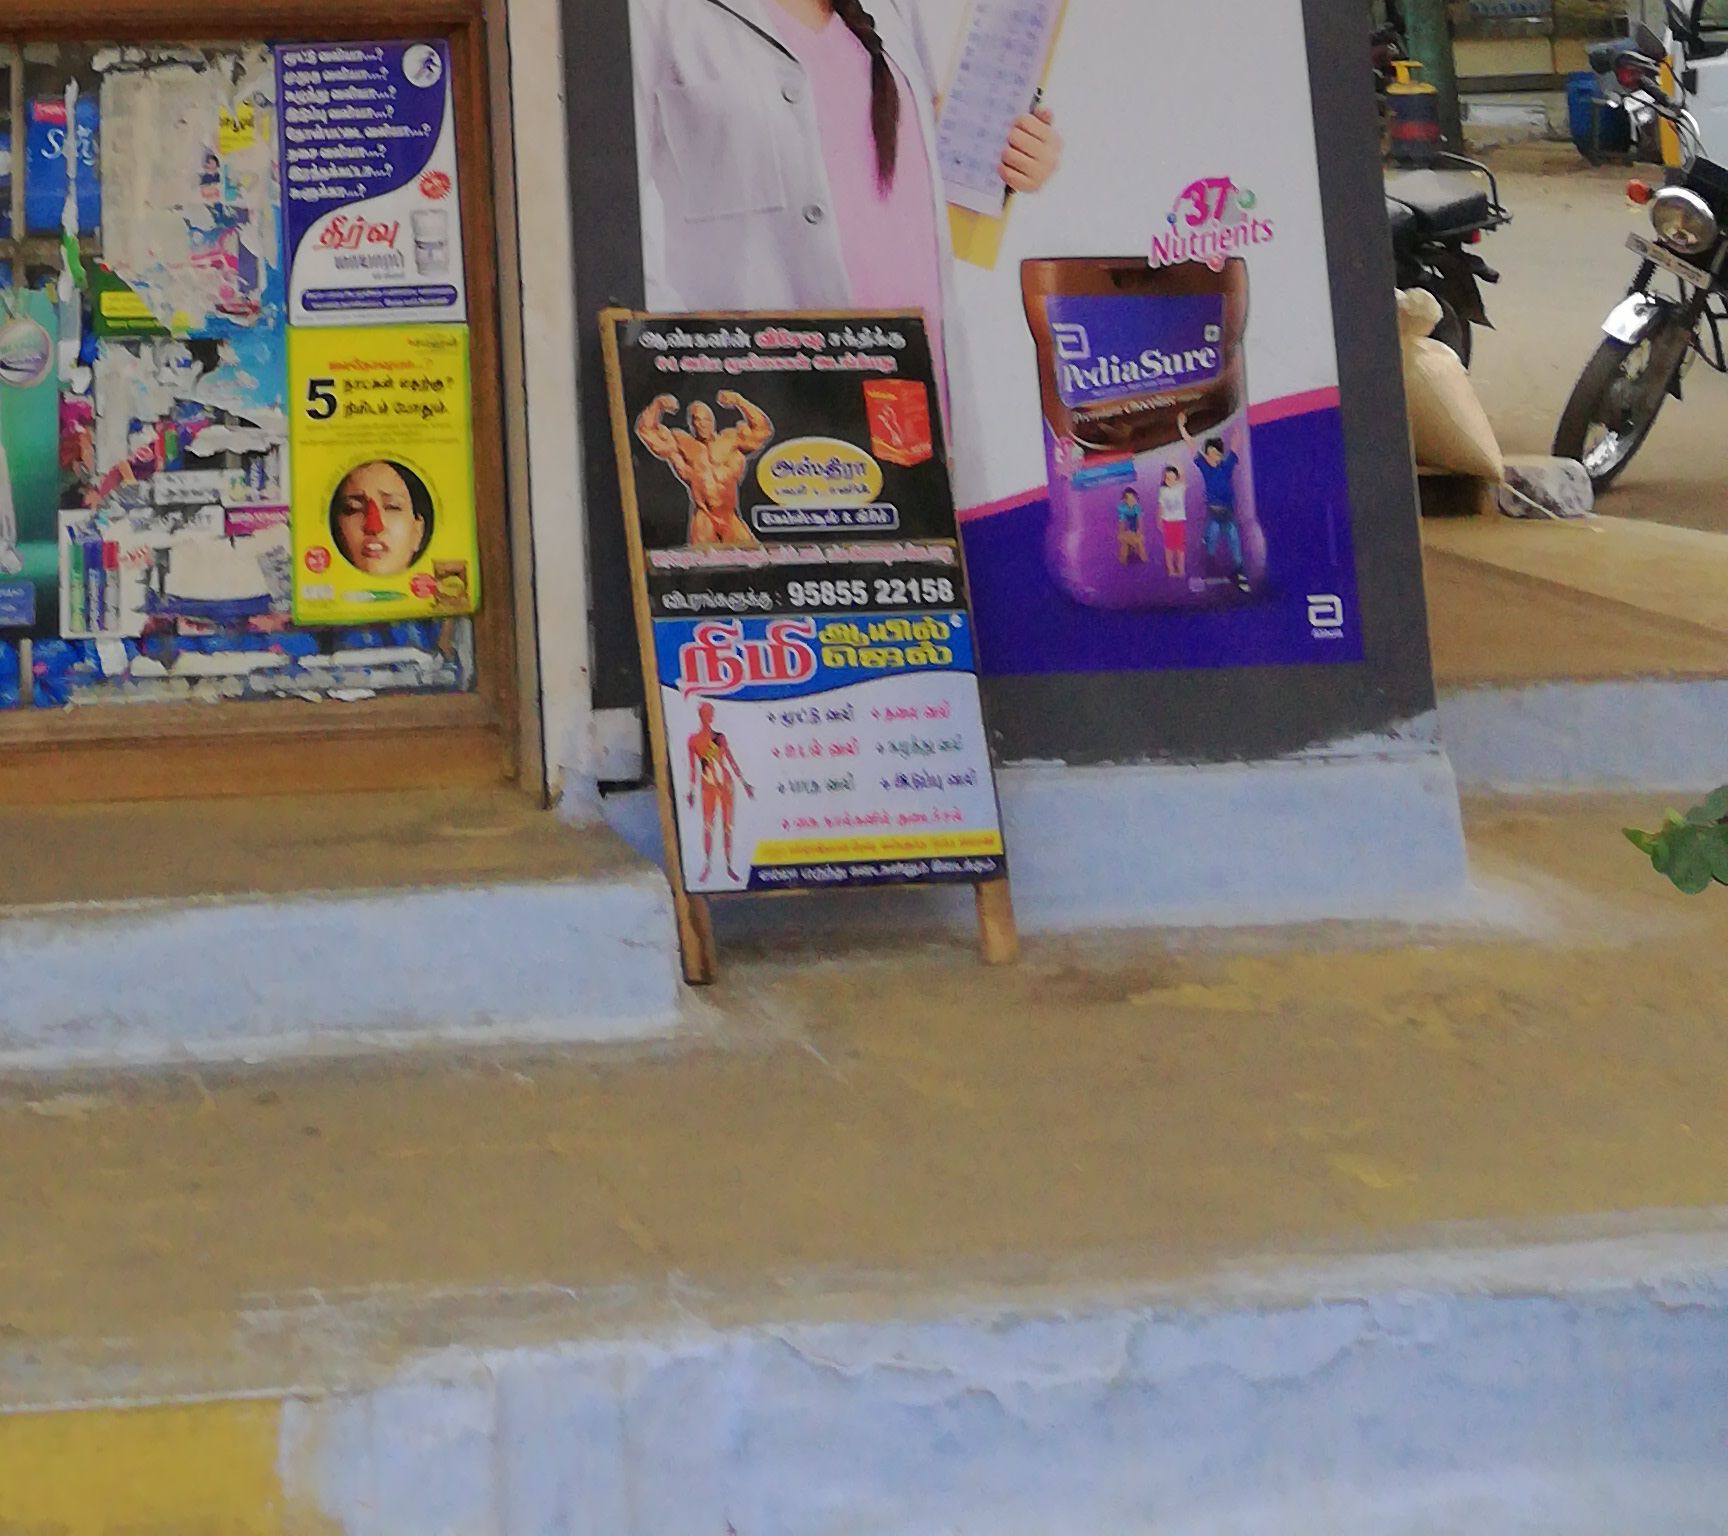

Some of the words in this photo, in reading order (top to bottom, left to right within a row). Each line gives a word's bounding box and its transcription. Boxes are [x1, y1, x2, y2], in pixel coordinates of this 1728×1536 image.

[305, 379, 338, 420] 5
[786, 578, 869, 607] 95855
[874, 577, 955, 605] 22158
